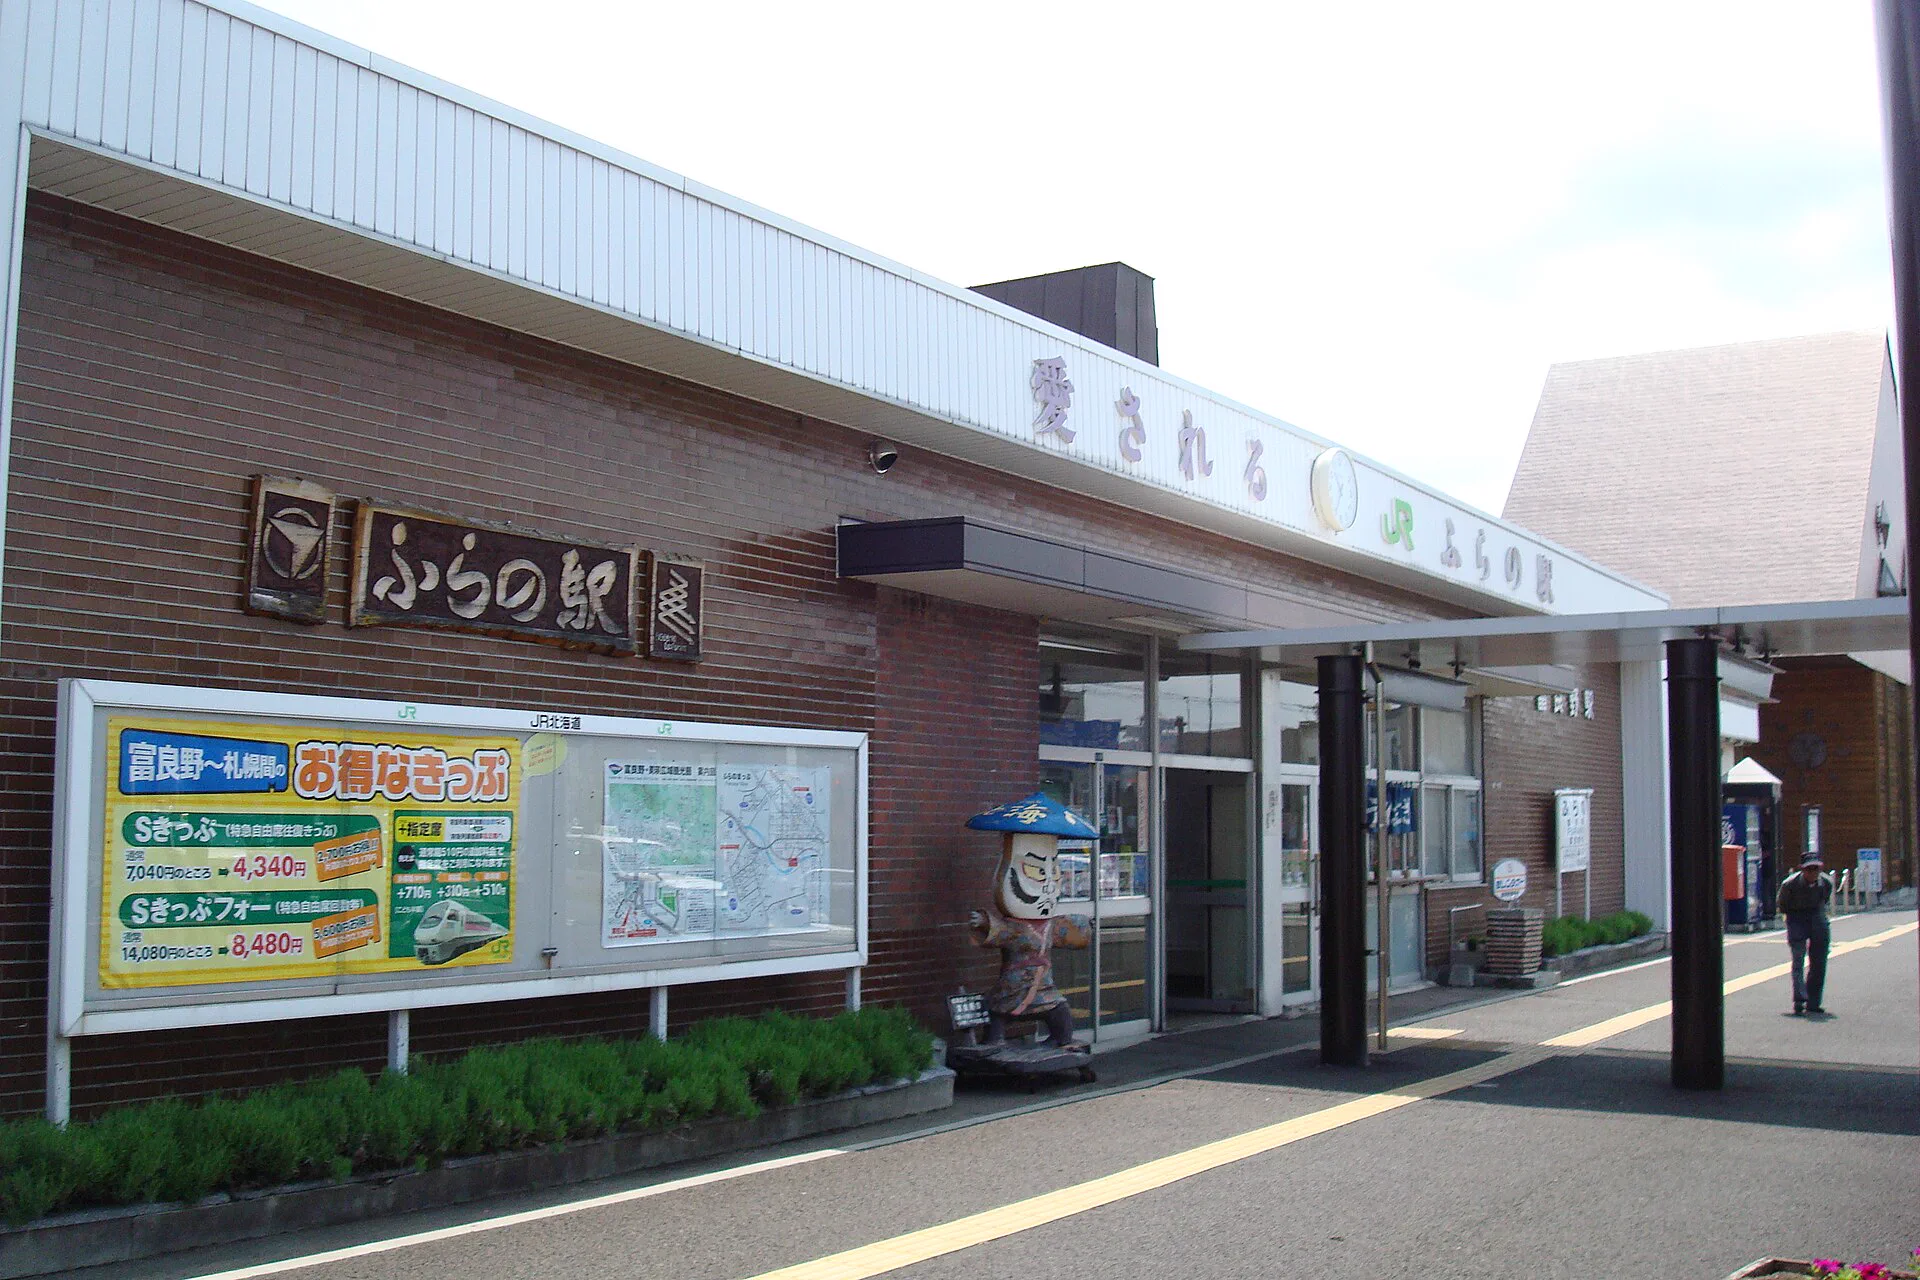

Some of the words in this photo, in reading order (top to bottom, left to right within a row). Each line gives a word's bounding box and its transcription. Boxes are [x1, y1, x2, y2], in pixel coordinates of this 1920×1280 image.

[1031, 356, 1267, 501] 愛される
[1380, 498, 1415, 552] JR
[372, 521, 625, 636] ふらの駅
[398, 705, 417, 720] JR
[530, 714, 581, 730] JR北海道
[657, 722, 673, 736] JR
[297, 745, 508, 798] お得なきっぷ
[134, 815, 218, 843] Sきっぷ
[126, 865, 212, 881] 7,040円のところ
[233, 855, 306, 881] 4,340円
[131, 896, 272, 925] Sきっぷフォー
[232, 932, 303, 960] 8,480円
